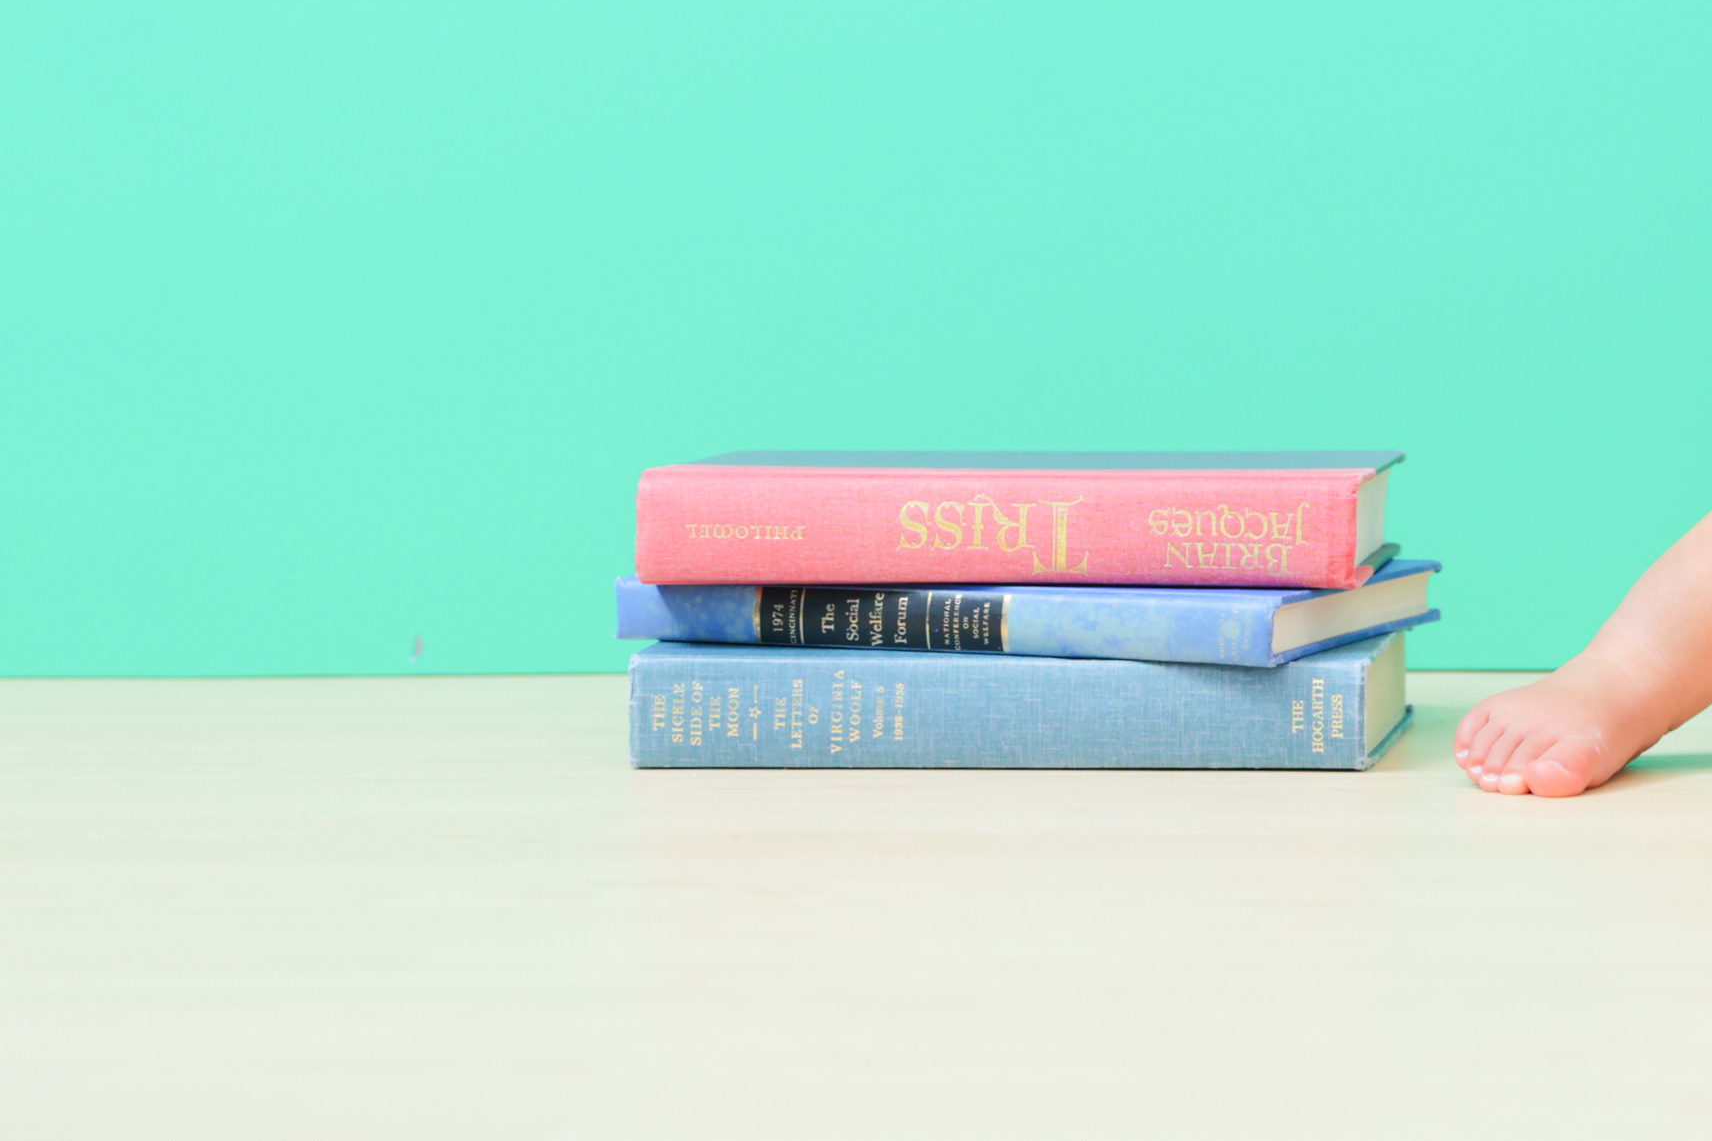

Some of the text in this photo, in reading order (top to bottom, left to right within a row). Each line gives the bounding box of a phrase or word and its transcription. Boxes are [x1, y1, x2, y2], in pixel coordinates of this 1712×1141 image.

[685, 523, 806, 541] PHILOMEL
[1164, 542, 1294, 576] BRIAN
[772, 603, 785, 632] 1974
[788, 589, 798, 644] CINCINNATI
[821, 603, 835, 634] The
[845, 598, 860, 641] Social
[868, 592, 885, 646] Welfare
[894, 596, 909, 644] Forum
[943, 598, 952, 645] NATIONAL
[962, 616, 969, 630] ON
[972, 607, 980, 639] SOCIAL
[982, 602, 991, 645] WELFARE
[653, 695, 666, 731] THE
[672, 683, 686, 743] SICKLE
[690, 680, 704, 746] SIDE OF
[709, 696, 722, 731] THE
[726, 687, 740, 738] MOON
[774, 697, 787, 731] THE
[790, 679, 804, 749] LETTERS
[808, 704, 819, 725] OF
[830, 669, 845, 754] VIRGINIA
[849, 679, 863, 743] WOOLF
[1291, 700, 1304, 734] THE
[1312, 678, 1325, 753] HOGARTH
[1331, 694, 1344, 738] PRESS
